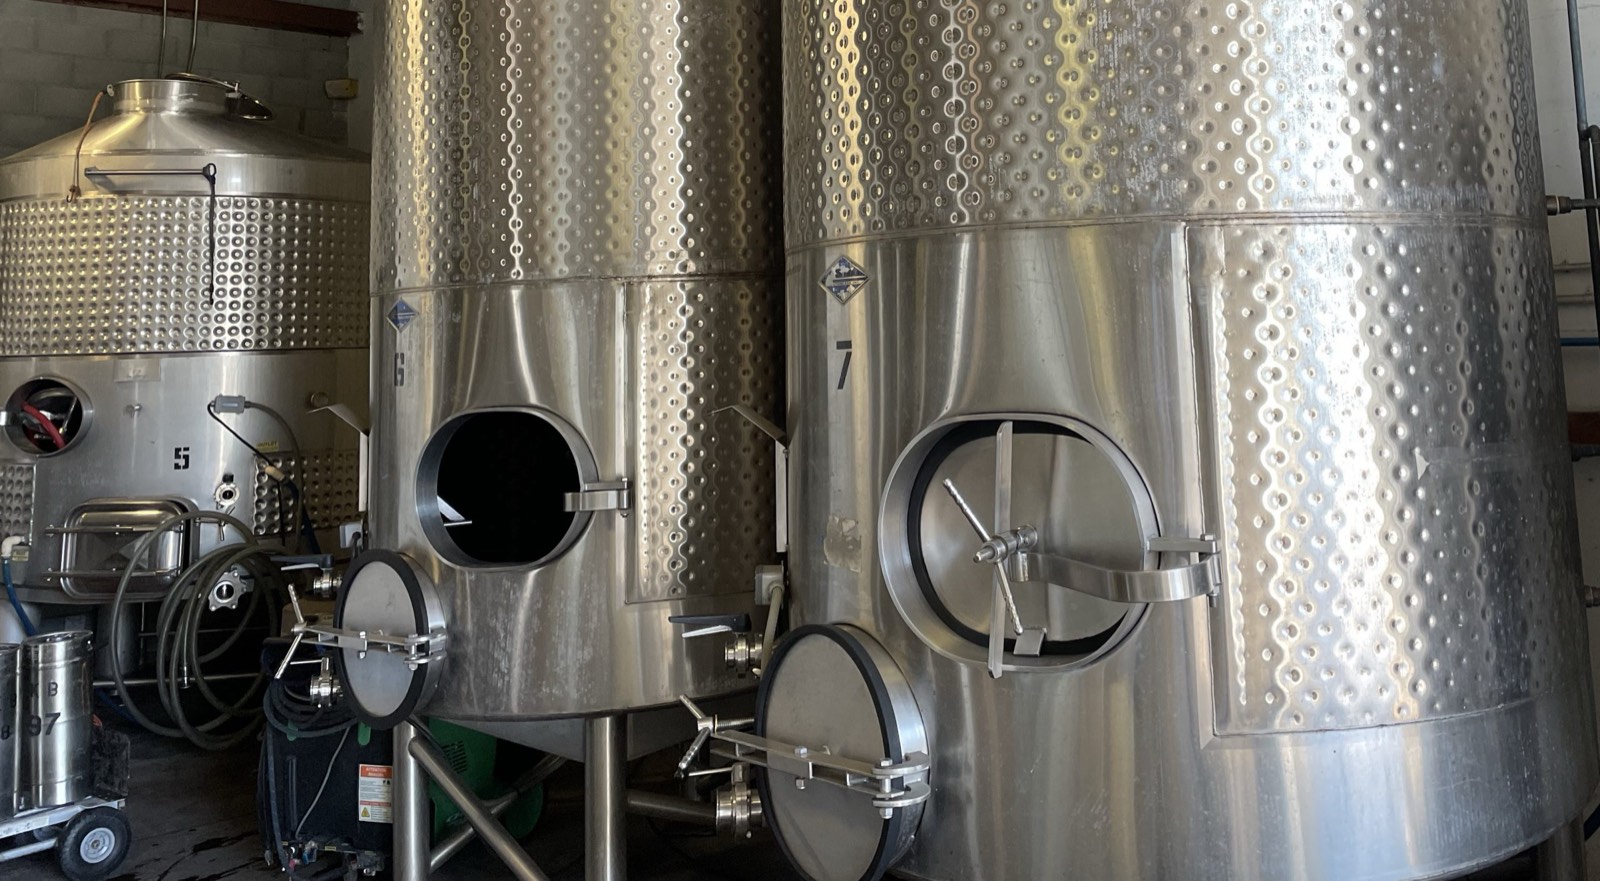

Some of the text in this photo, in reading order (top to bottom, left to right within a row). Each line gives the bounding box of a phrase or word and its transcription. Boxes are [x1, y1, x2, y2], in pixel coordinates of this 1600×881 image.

[394, 352, 404, 387] 6
[836, 340, 852, 390] 7
[174, 447, 190, 470] 5
